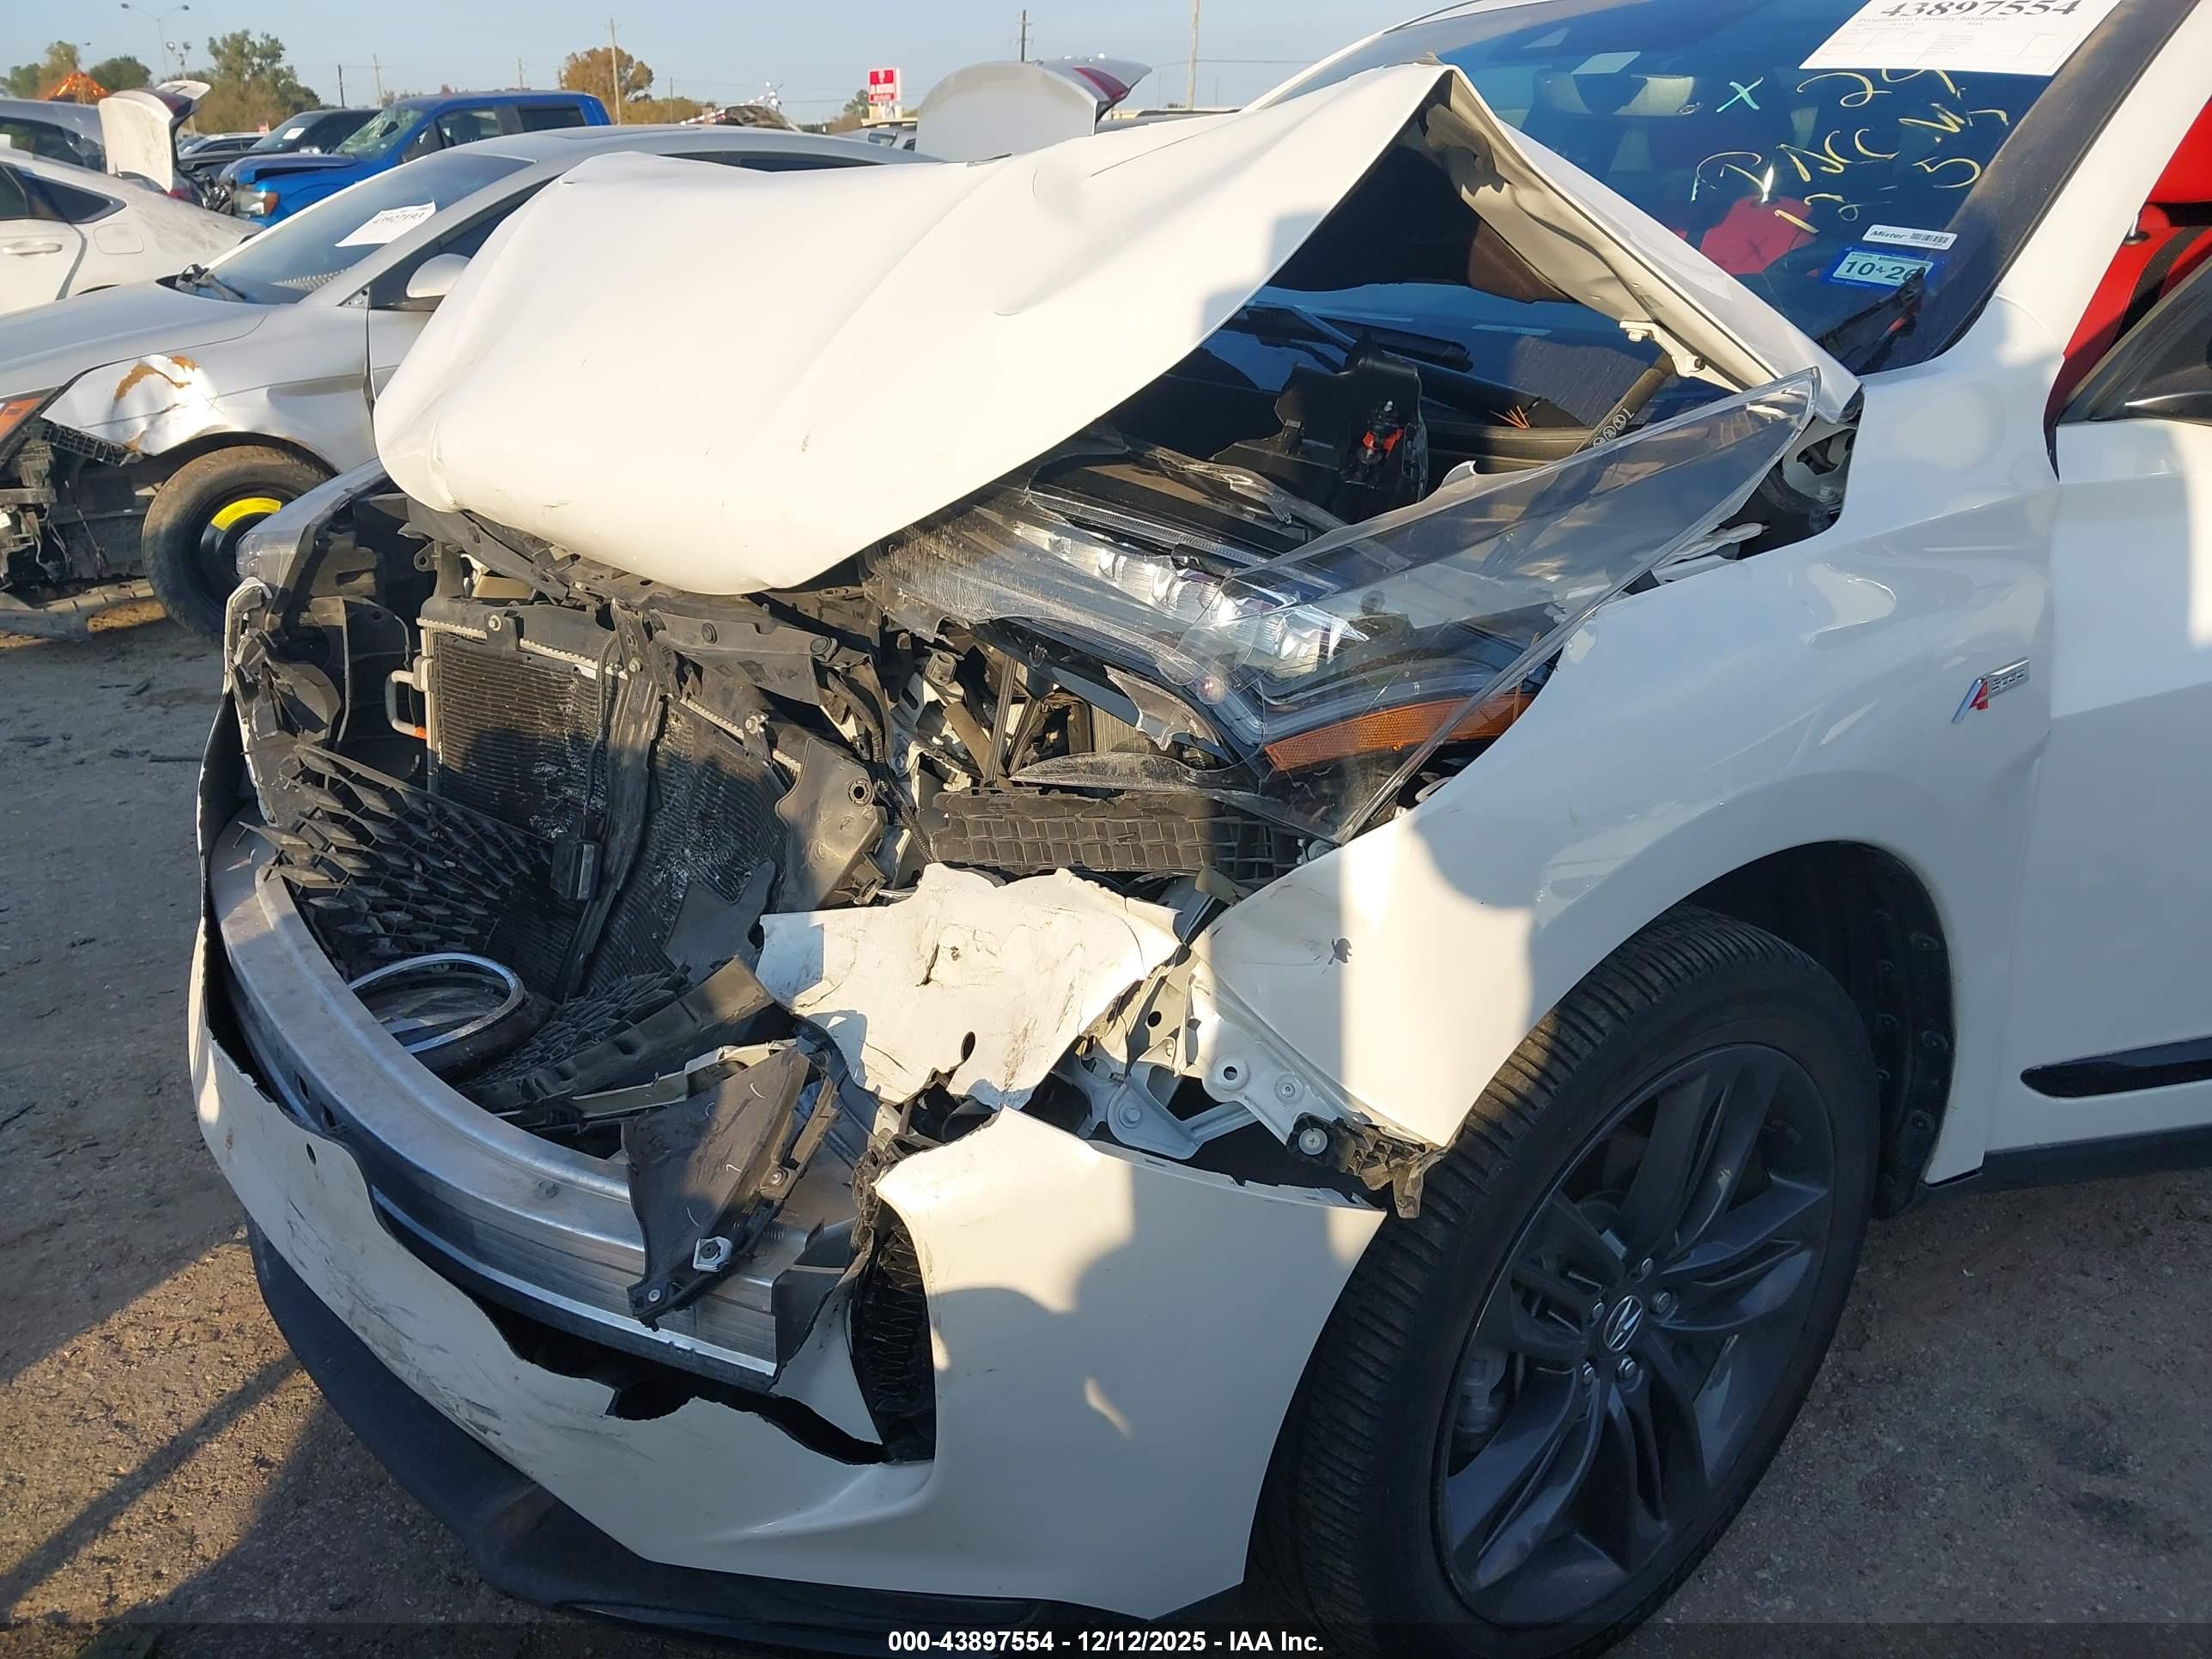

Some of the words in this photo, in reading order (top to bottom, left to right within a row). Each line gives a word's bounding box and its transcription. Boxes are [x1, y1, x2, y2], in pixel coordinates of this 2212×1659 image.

[1880, 1, 2082, 16] 43897554
[1869, 229, 1909, 240] Mister
[1845, 260, 1876, 276] 10
